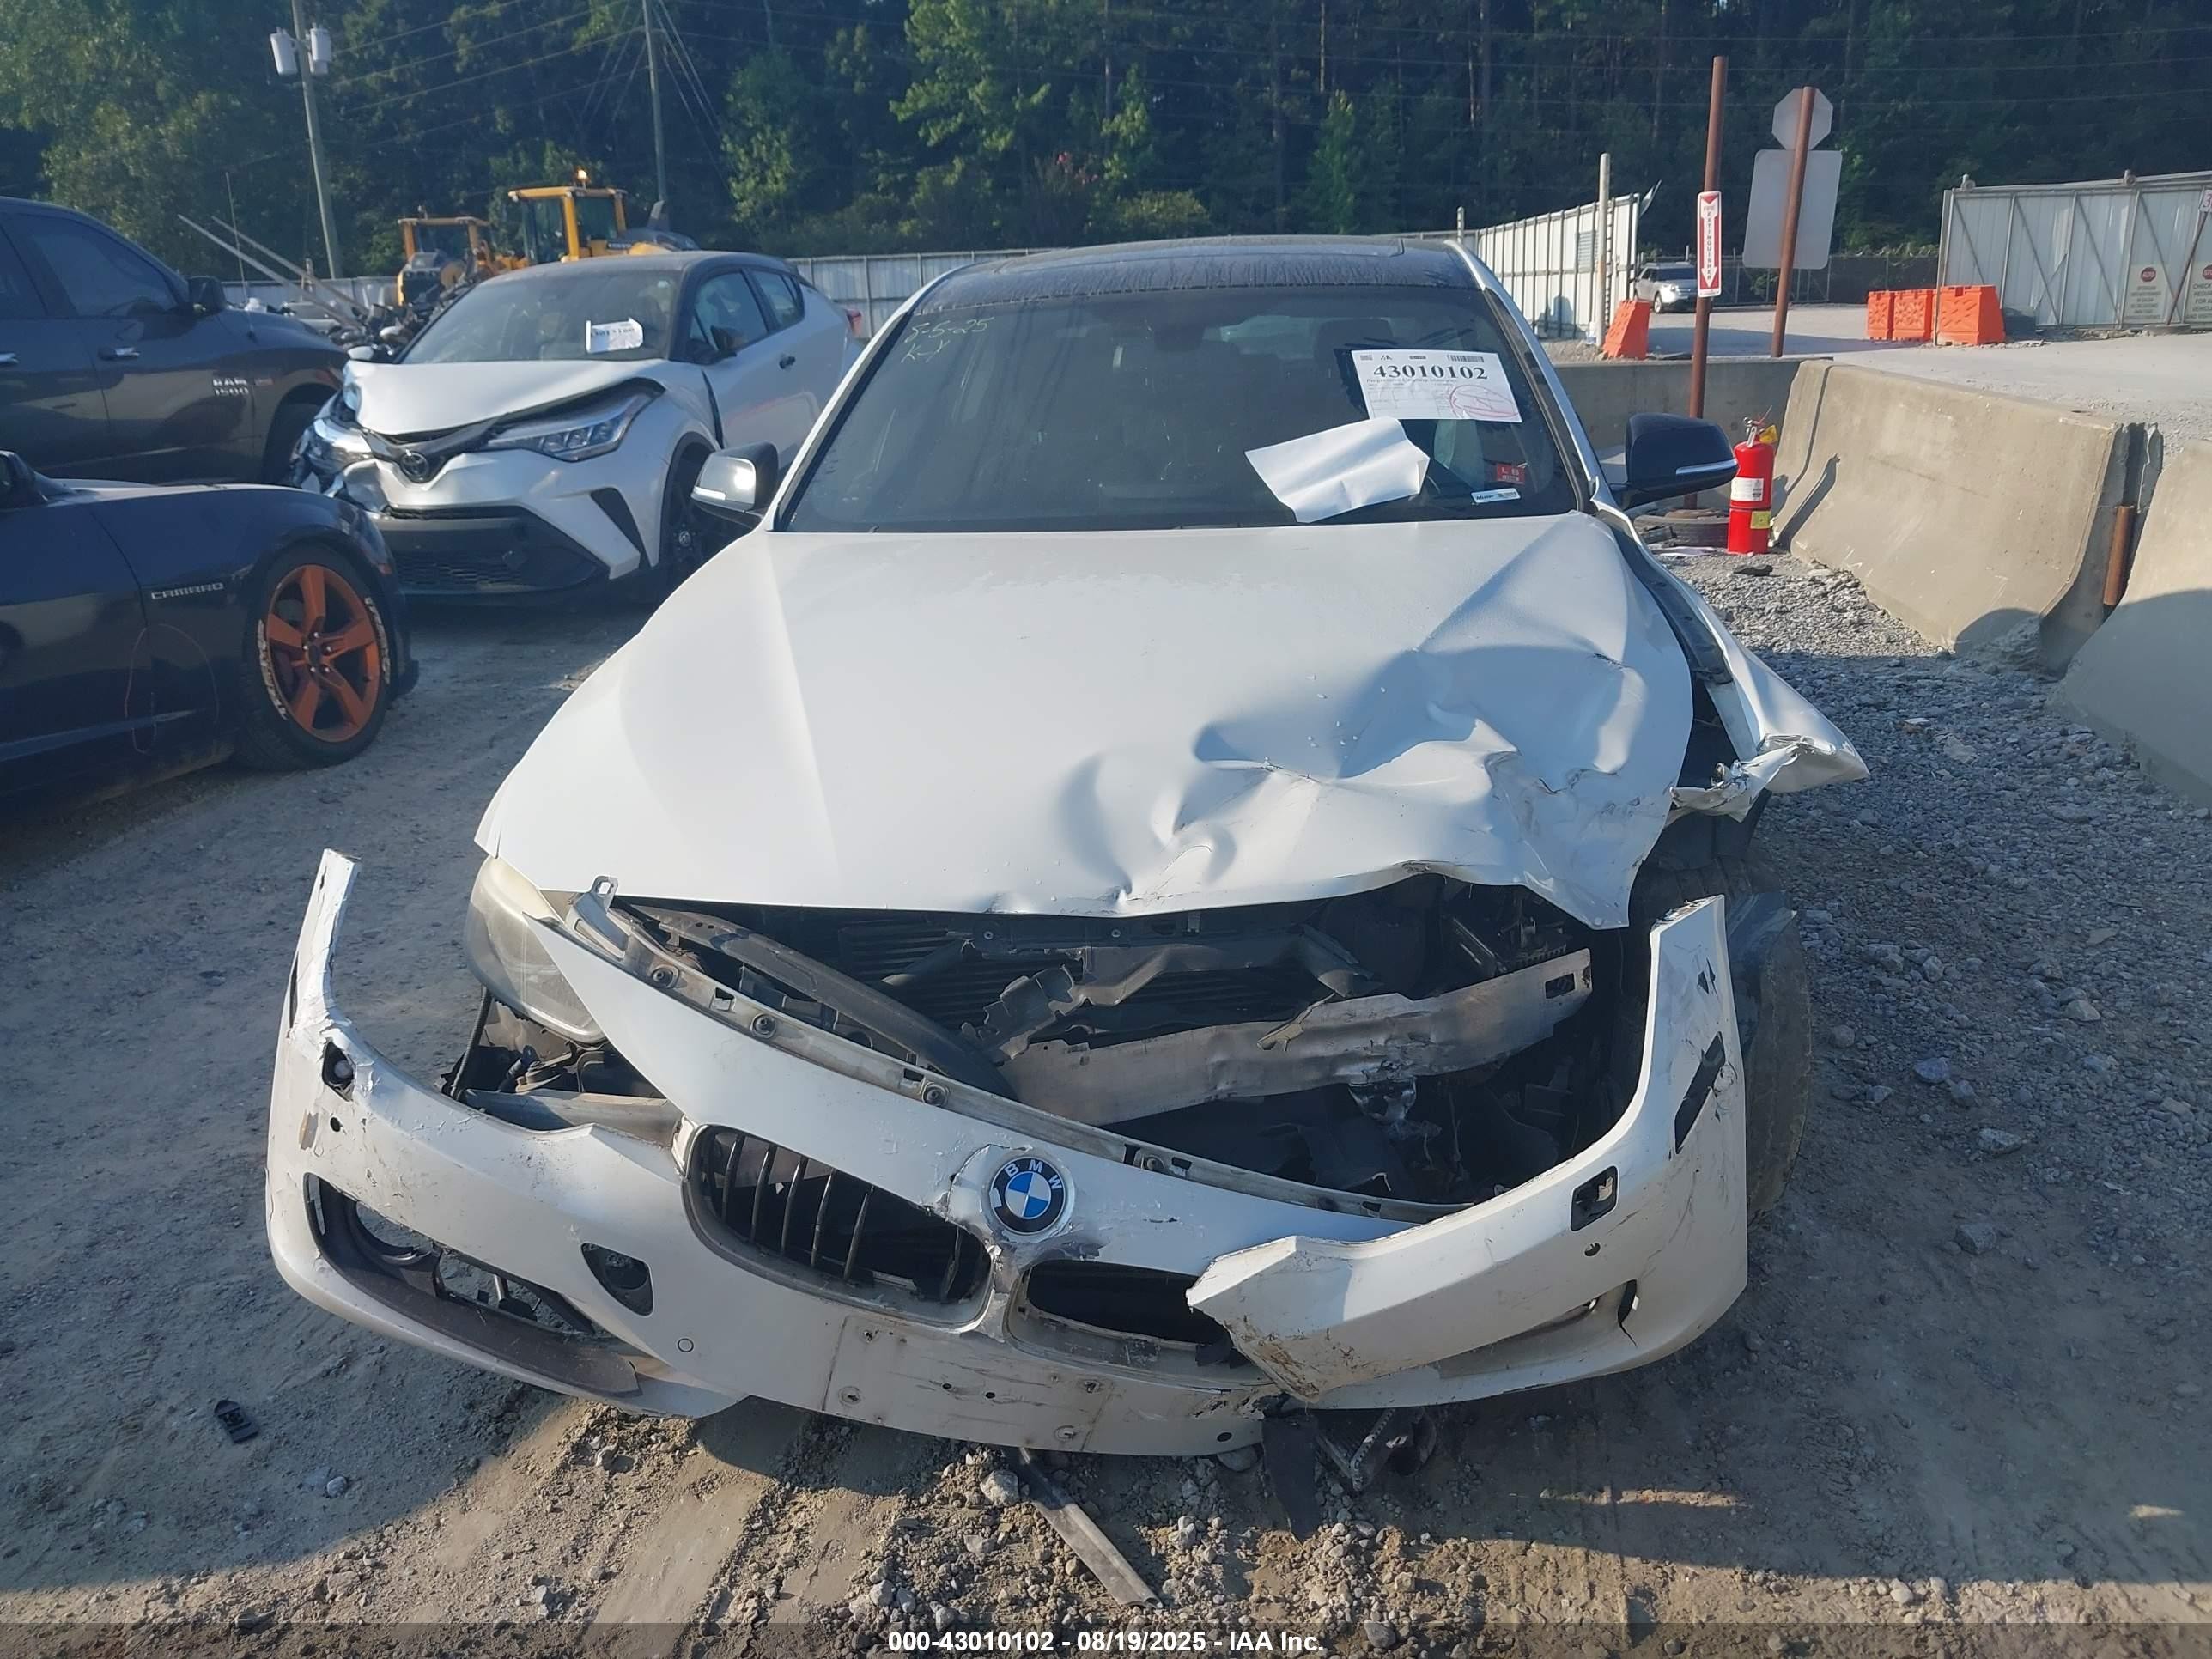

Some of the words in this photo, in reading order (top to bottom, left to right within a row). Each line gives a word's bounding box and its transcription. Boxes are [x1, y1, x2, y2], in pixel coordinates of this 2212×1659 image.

[1374, 365, 1488, 380] 43010102
[151, 583, 223, 599] CAMARO
[1004, 1159, 1063, 1190] BMW
